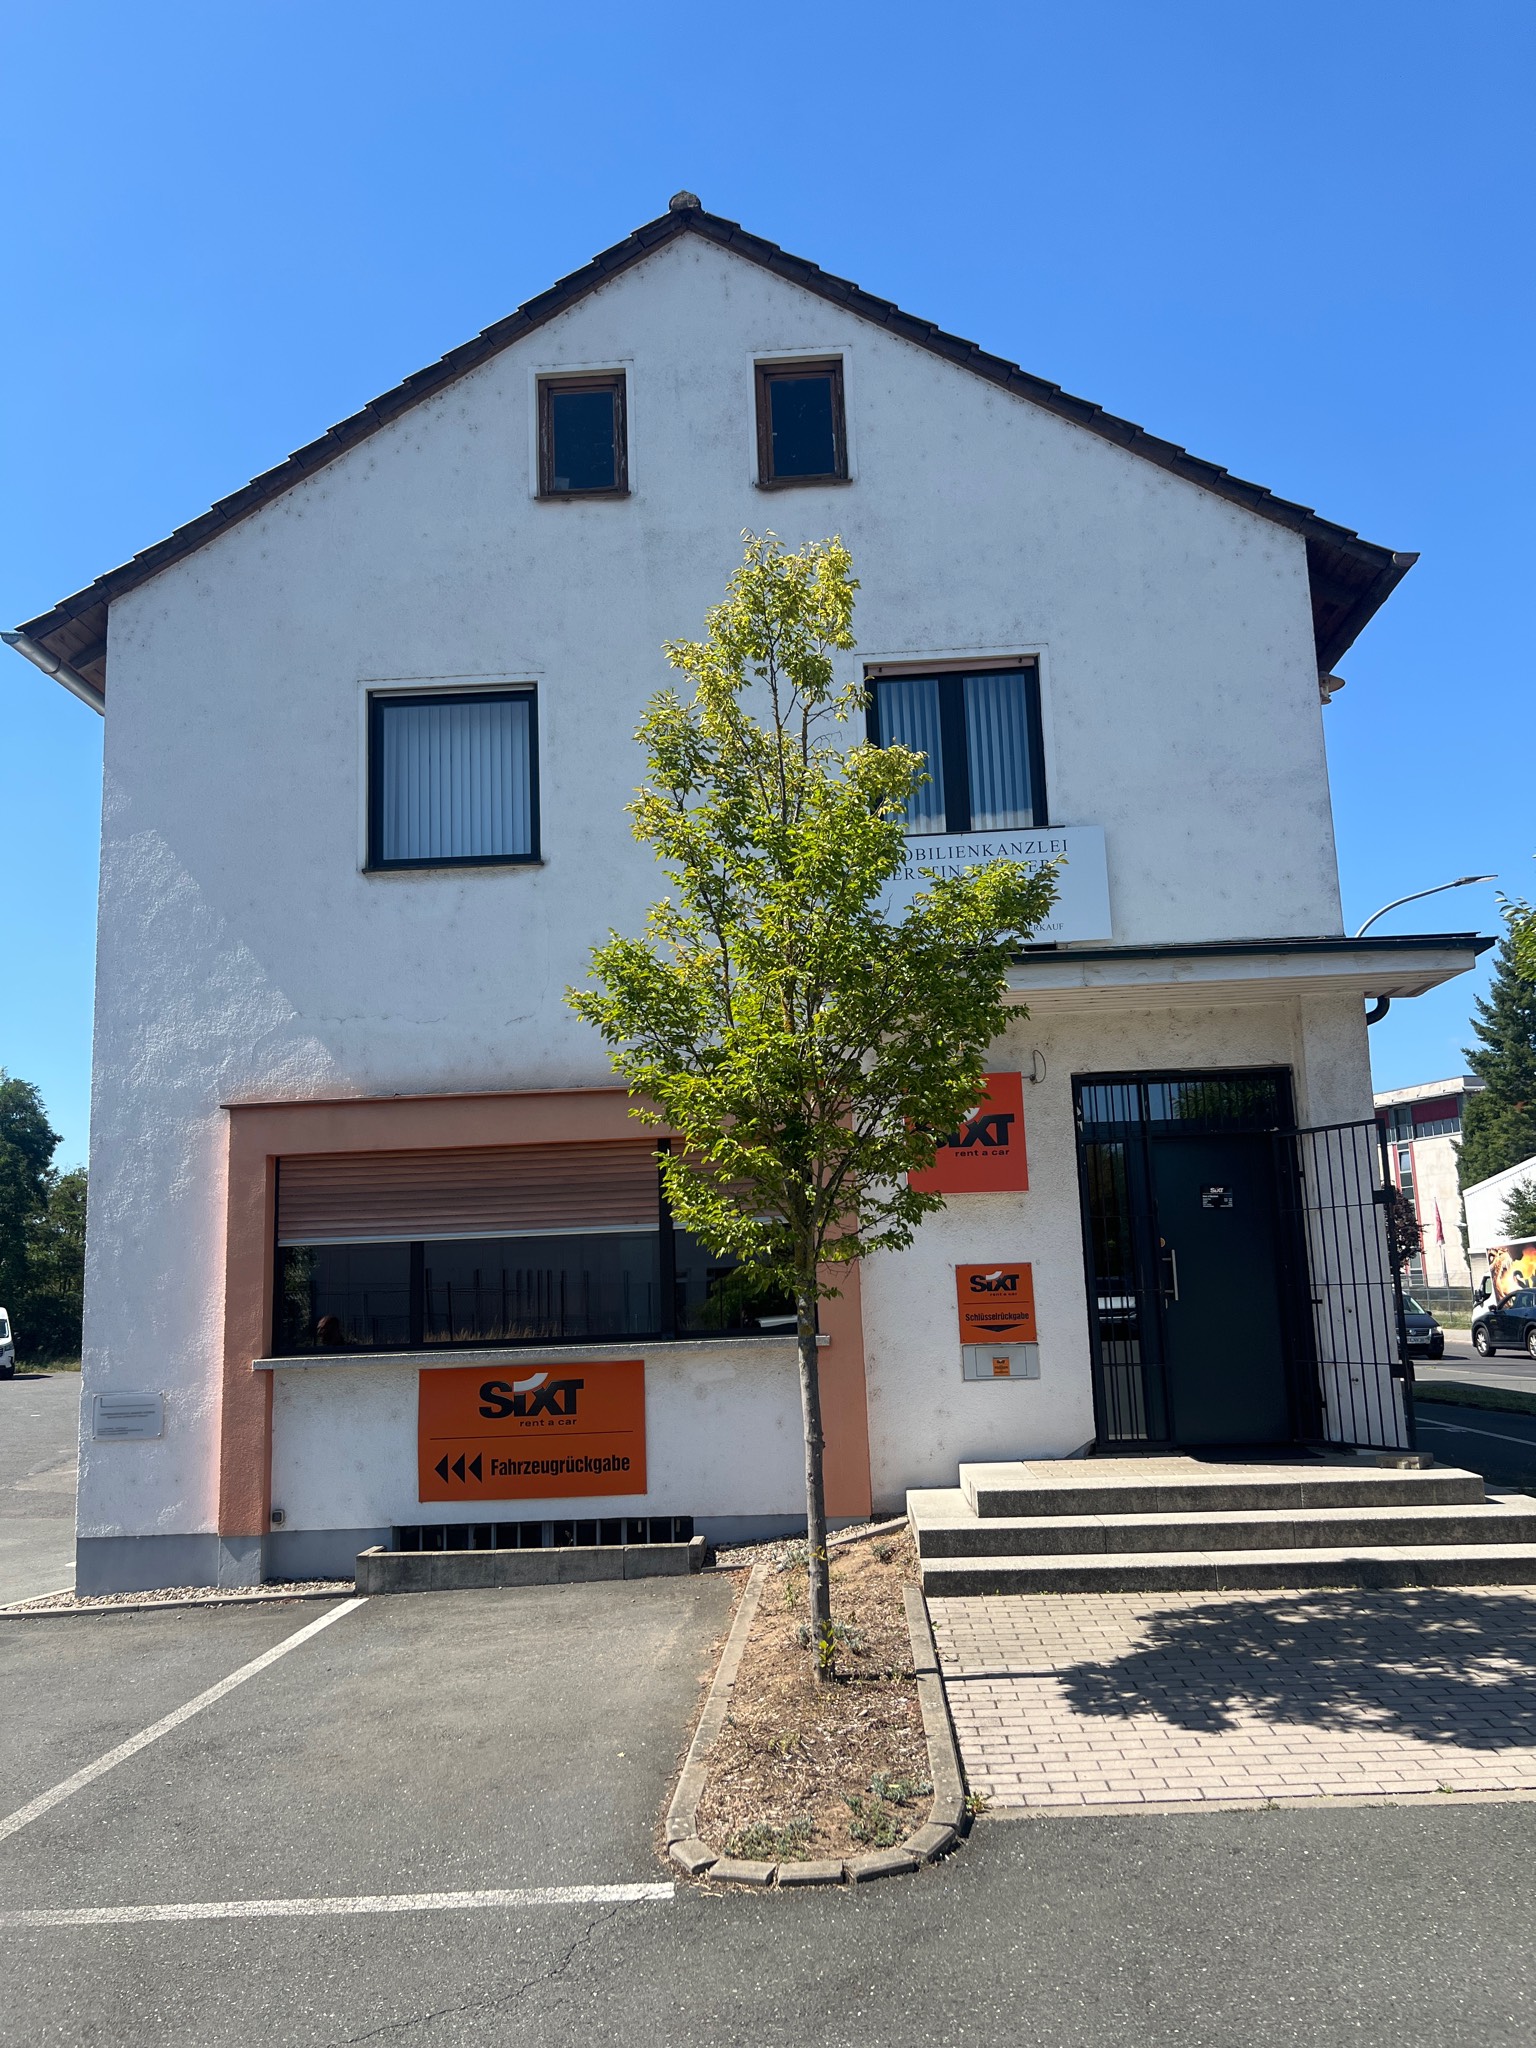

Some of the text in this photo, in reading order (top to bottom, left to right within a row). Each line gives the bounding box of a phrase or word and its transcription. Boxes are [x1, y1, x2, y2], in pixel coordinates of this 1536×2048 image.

[901, 839, 1068, 862] OBILIENKANZLEI
[1029, 922, 1064, 931] ERKAUF
[965, 1311, 1030, 1322] Schlüsselrückgabe
[519, 1419, 545, 1427] rent
[558, 1418, 577, 1426] car
[491, 1454, 631, 1476] Fahrzeugrückgabe
